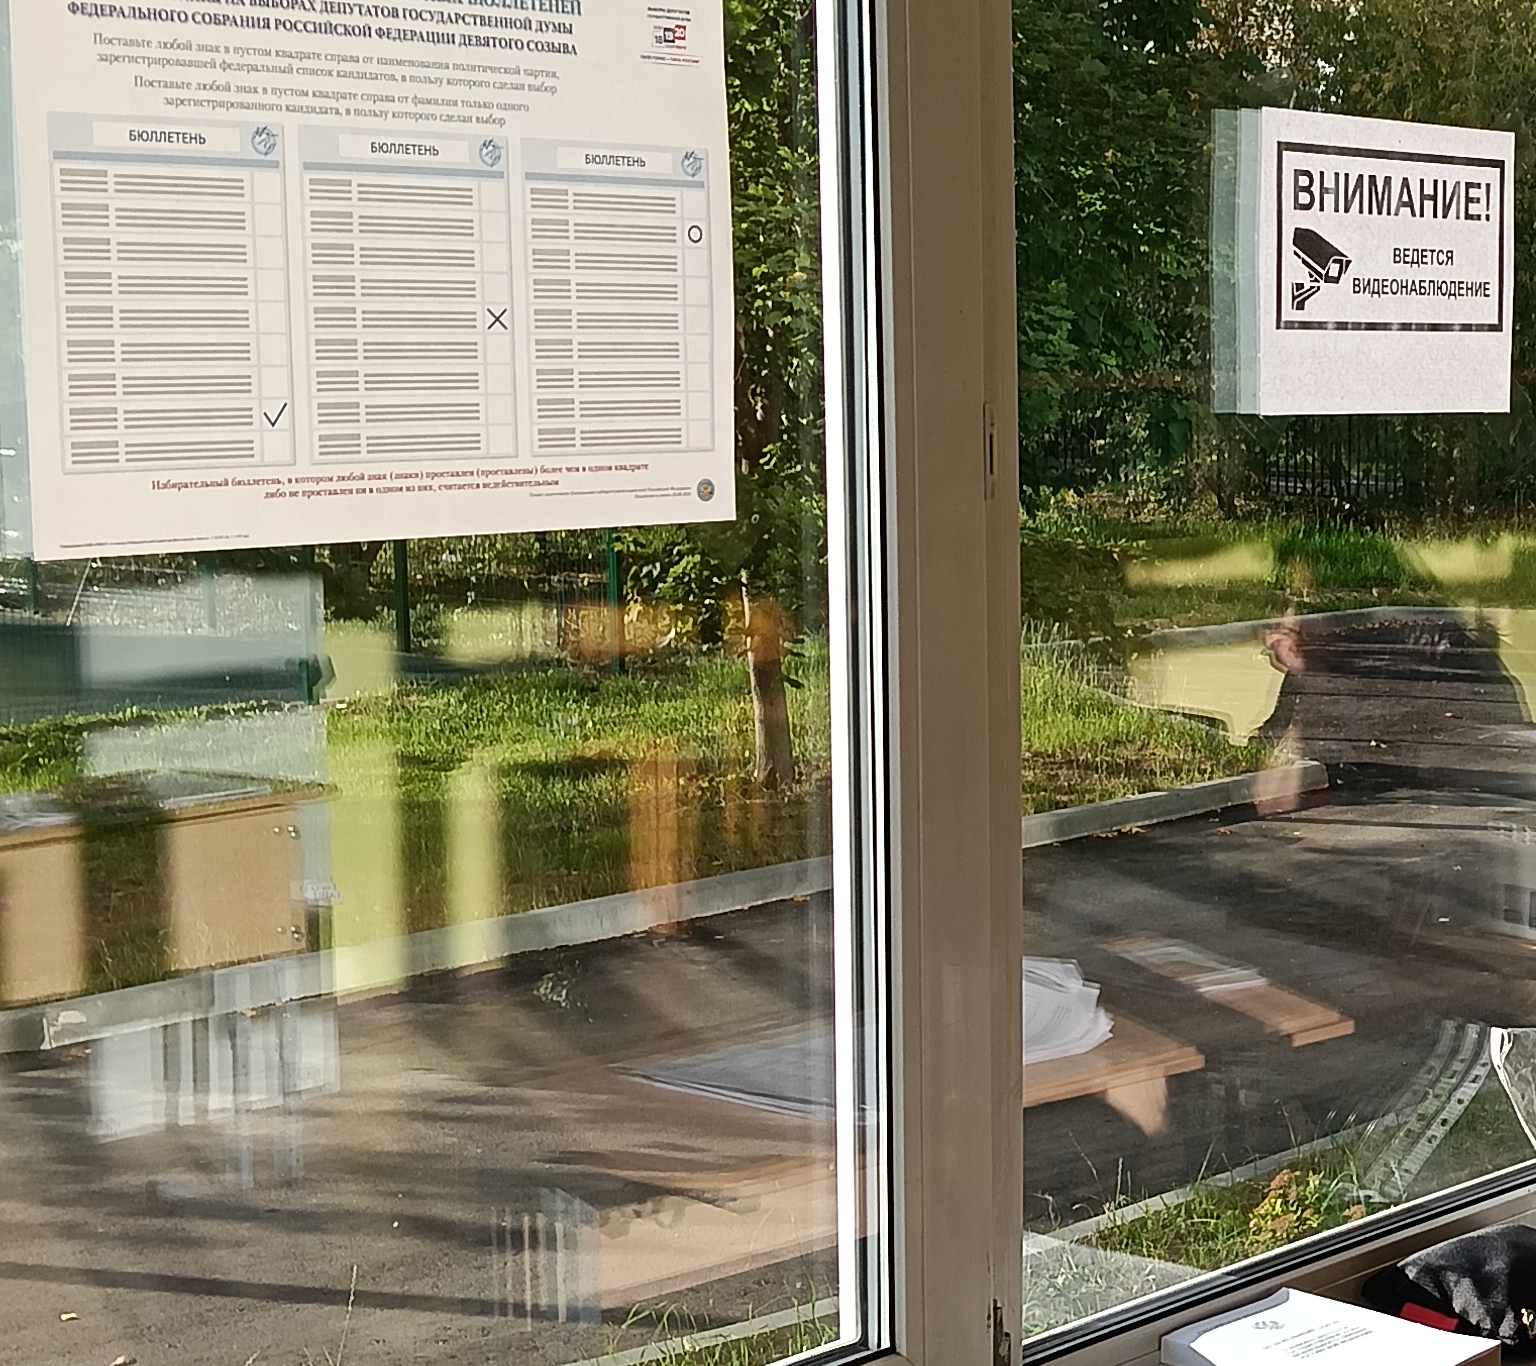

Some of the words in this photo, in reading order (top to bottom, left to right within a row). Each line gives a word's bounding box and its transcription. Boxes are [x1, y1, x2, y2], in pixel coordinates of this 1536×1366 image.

[68, 2, 188, 22] ФЕДЕРАЛЬНОГО
[192, 12, 271, 30] СОБРАНИЯ
[275, 18, 372, 38] РОССИЙСКОЙ
[375, 27, 455, 45] ФЕДЕРАЦИИ
[459, 34, 524, 50] ДЕВЯТОГО
[527, 40, 577, 55] СОЗЫВА
[320, 1, 399, 18] ДЕПУТАТОВ
[403, 8, 532, 31] ГОСУДАРСТВЕННОЙ
[535, 21, 572, 34] ДУМЫ
[128, 128, 207, 146] БЮЛЛЕТЕНЬ
[370, 140, 440, 158] БЮЛЛЕТЕНЬ
[584, 152, 646, 169] БЮЛЛЕТЕНЬ
[1293, 169, 1492, 222] ВНИМАНИЕ!
[1392, 247, 1454, 268] ВЕДЕТСЯ
[1352, 277, 1491, 300] ВИДЕОНАБЛЮДЕНИЕ
